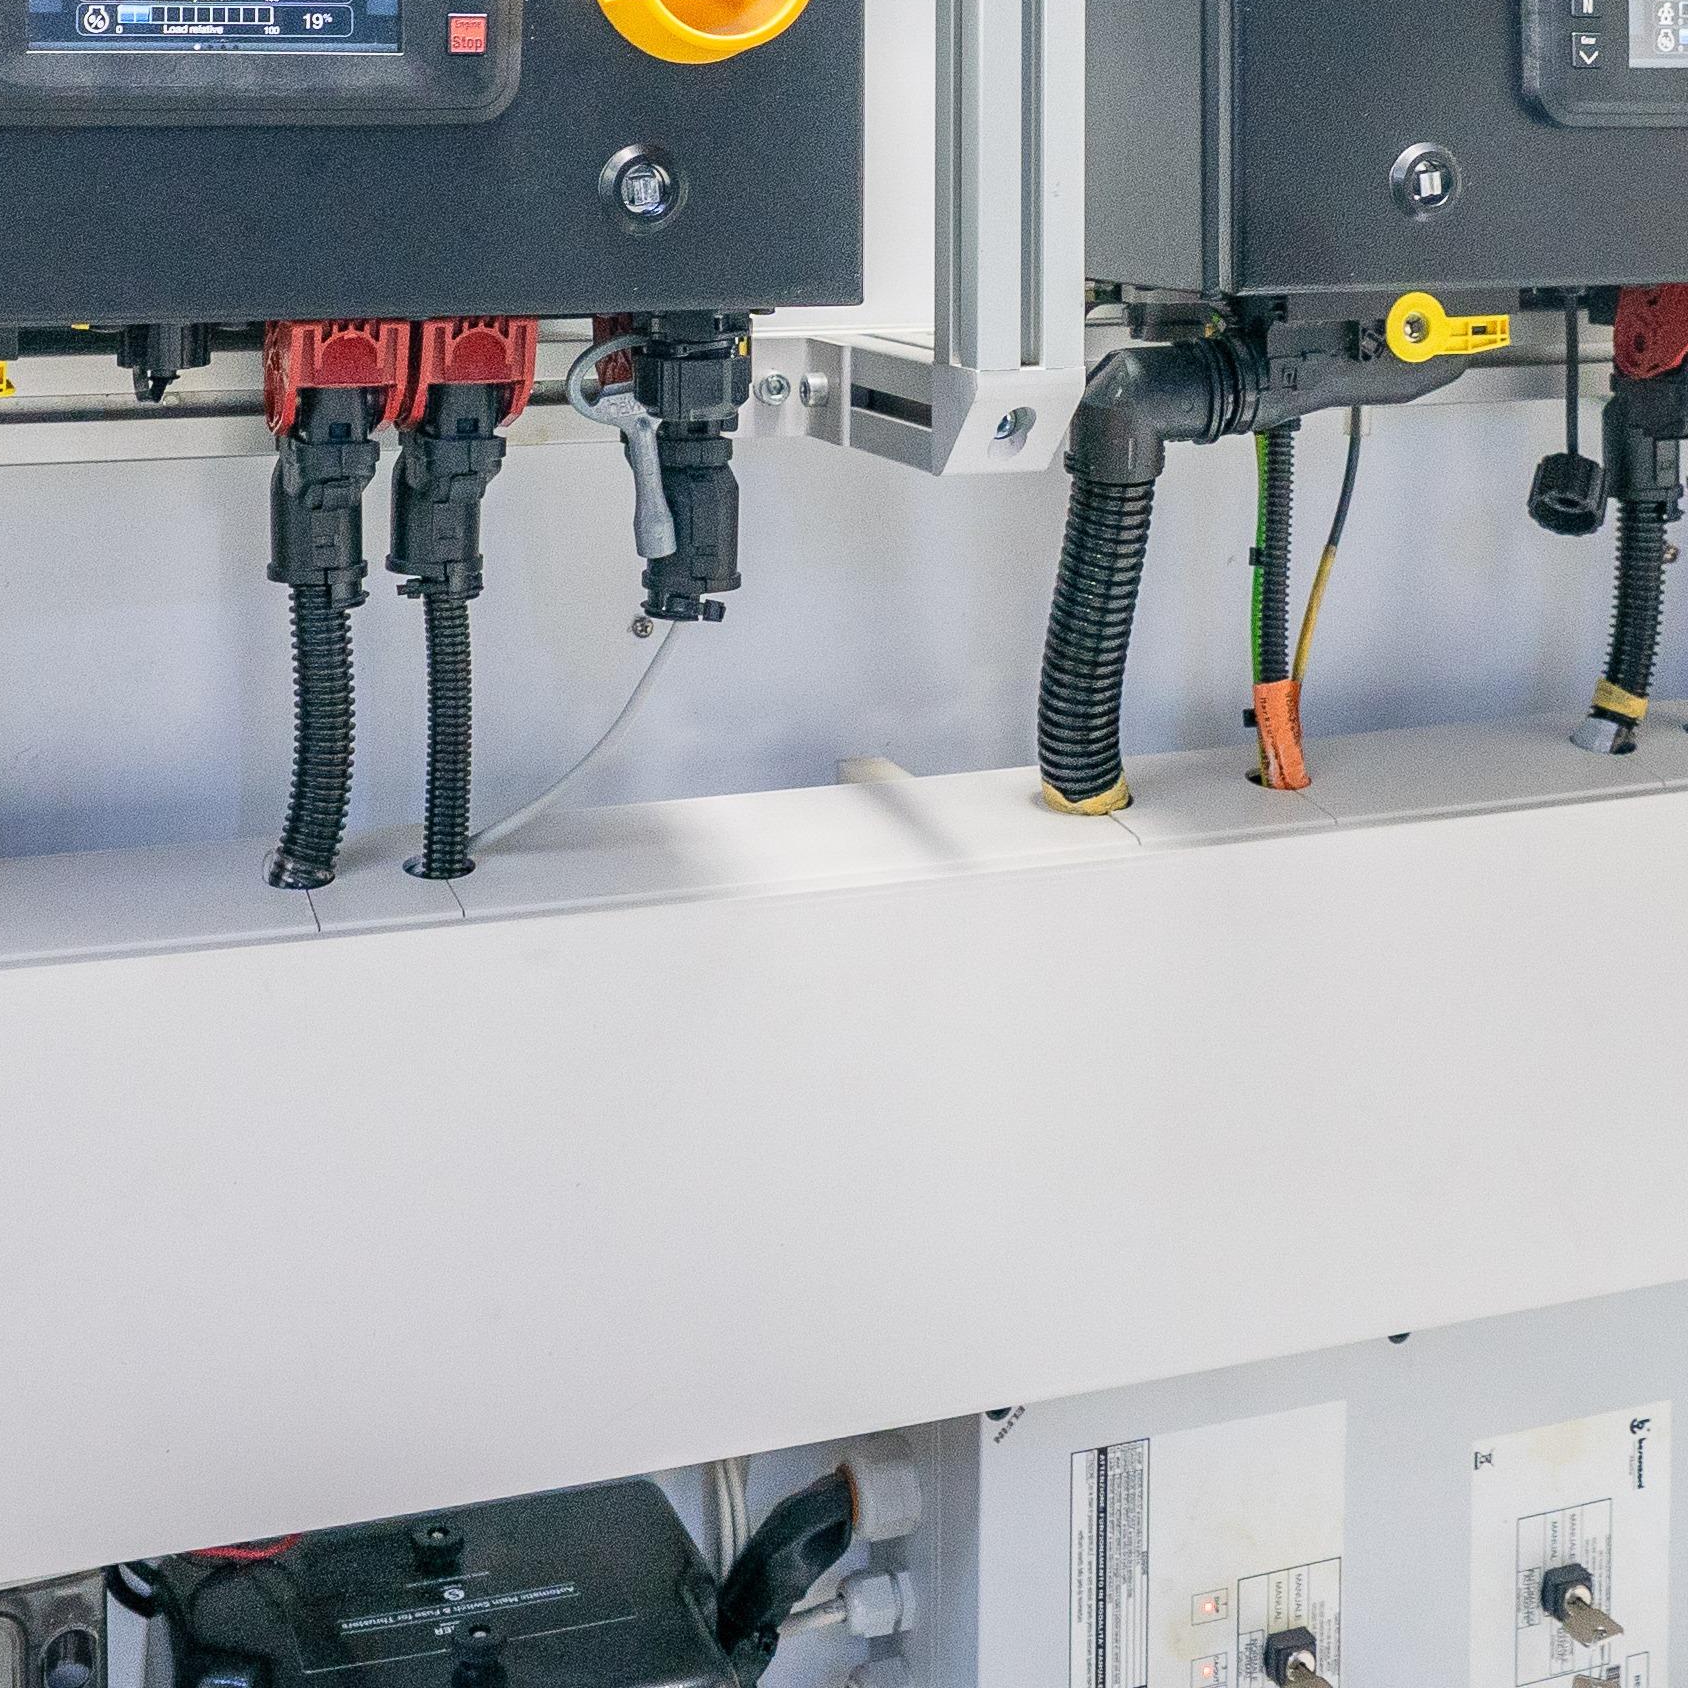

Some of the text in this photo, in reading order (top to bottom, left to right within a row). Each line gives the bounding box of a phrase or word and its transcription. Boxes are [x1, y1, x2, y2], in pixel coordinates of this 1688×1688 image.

[163, 24, 186, 34] Load
[187, 25, 224, 35] relative
[452, 36, 483, 51] Stop
[520, 1586, 575, 1602] Automatic
[456, 1599, 491, 1613] Switch
[491, 1596, 520, 1606] Main
[397, 1612, 413, 1623] for
[414, 1607, 442, 1618] Fuse
[341, 1616, 395, 1630] Thrusters
